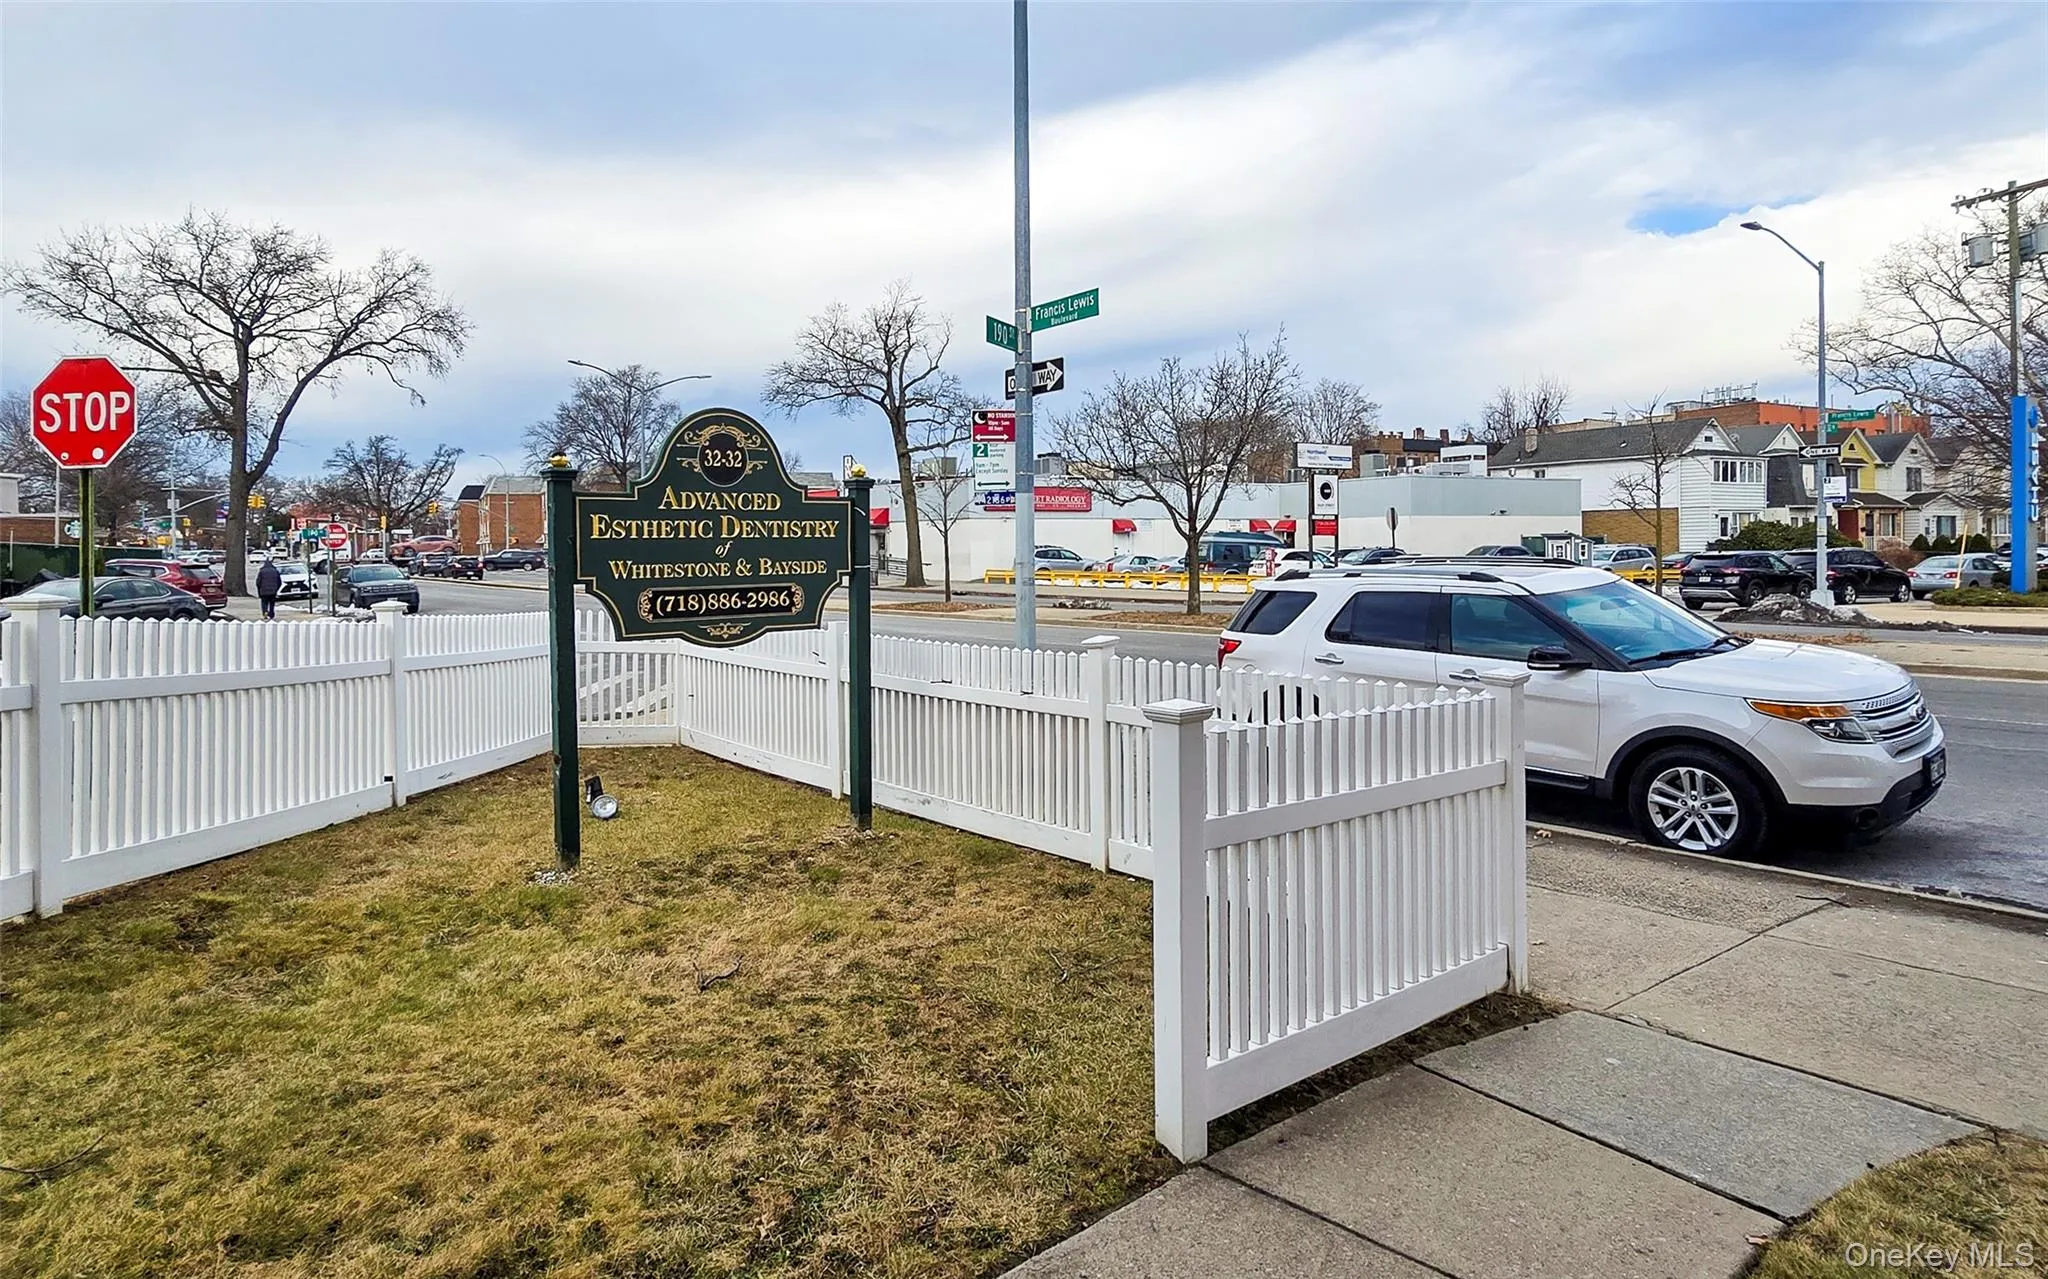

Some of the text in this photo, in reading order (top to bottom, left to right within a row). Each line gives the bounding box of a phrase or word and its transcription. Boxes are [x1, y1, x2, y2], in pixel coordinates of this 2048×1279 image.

[1035, 293, 1095, 321] Francis Lewis
[1050, 311, 1078, 326] Boulevard
[993, 322, 1008, 345] 190
[1037, 368, 1057, 385] WAY
[40, 391, 131, 434] STOP
[704, 450, 743, 468] 32-32
[976, 444, 985, 457] 2
[658, 485, 781, 511] ADVANCED
[1045, 495, 1086, 503] RADIOLOGY
[590, 514, 840, 539] ESTHETIC DENTISTRY
[715, 541, 733, 557] of
[608, 558, 827, 580] WHITESTONE & BAYSIDE
[656, 590, 790, 615] (718)886-2986
